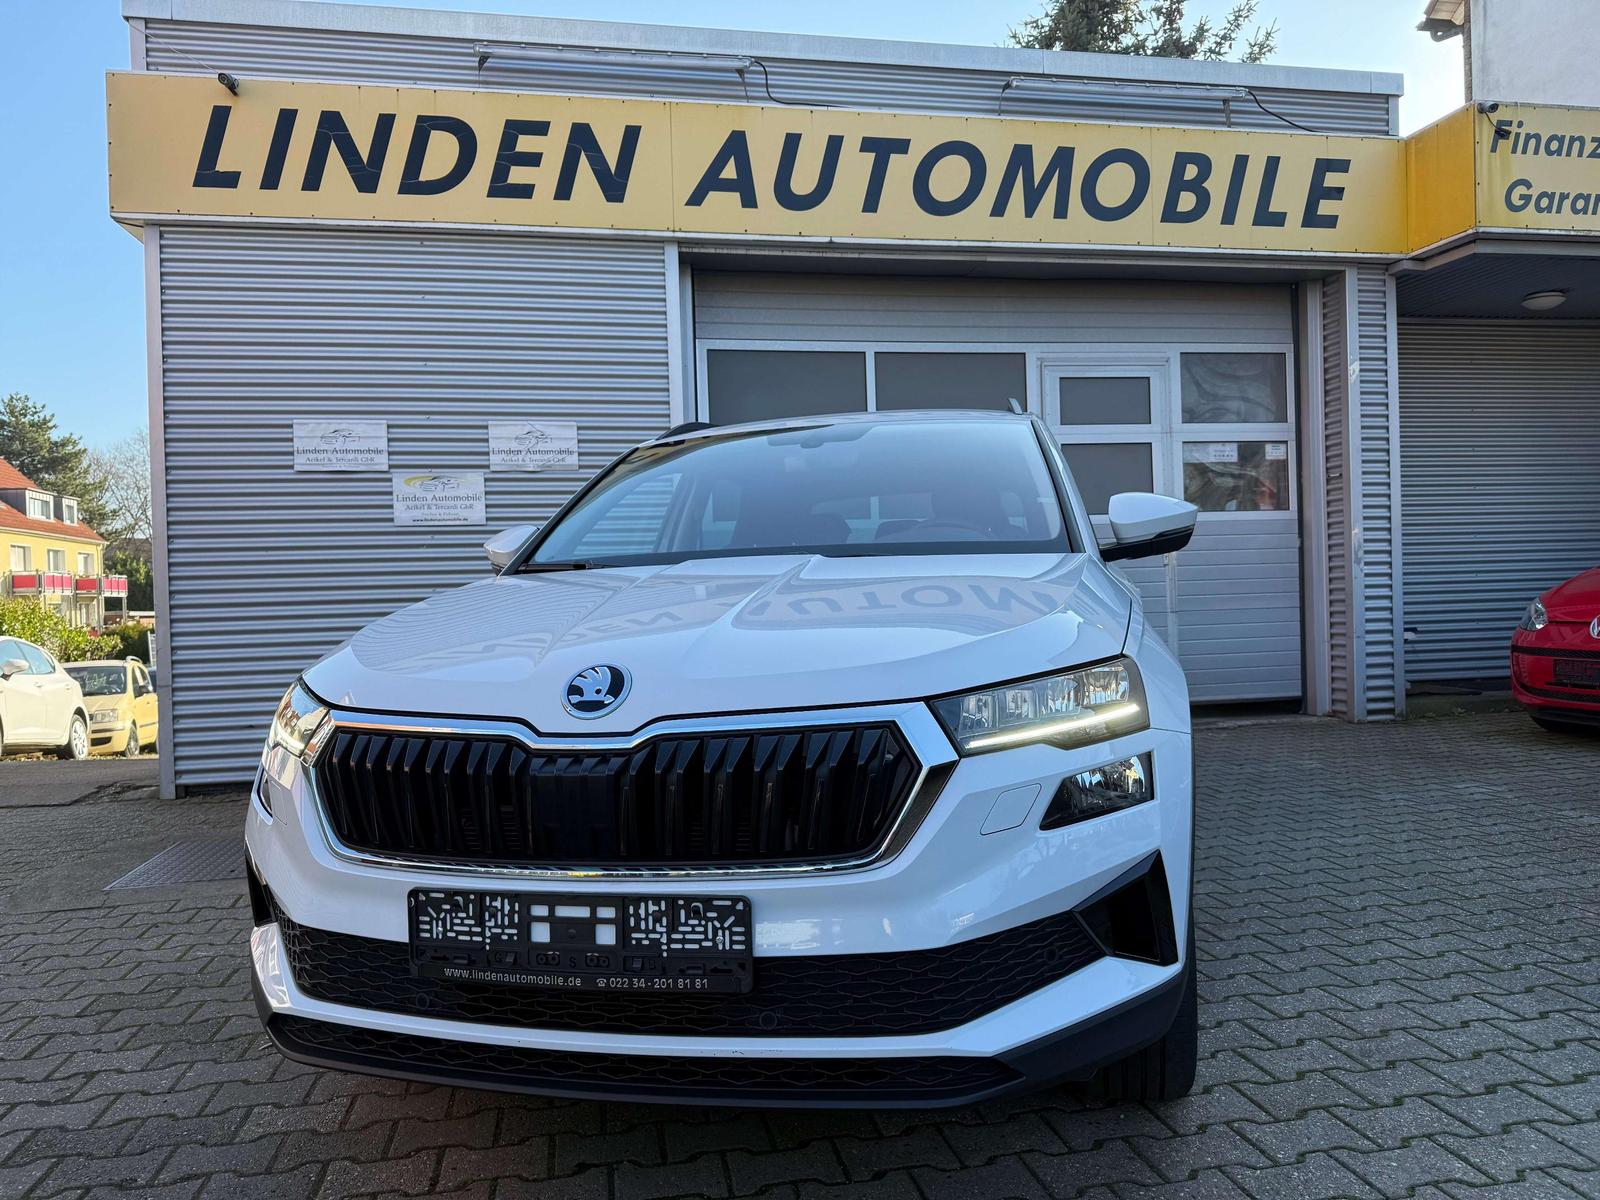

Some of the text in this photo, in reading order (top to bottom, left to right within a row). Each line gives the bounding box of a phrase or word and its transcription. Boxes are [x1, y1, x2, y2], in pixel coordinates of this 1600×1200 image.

[192, 105, 1352, 229] LINDEN AUTOMOBILE
[296, 446, 384, 456] Linden Automobile
[491, 447, 575, 456] Linden Automobile
[396, 493, 483, 502] Linden Automobile
[443, 967, 582, 986] www.lindenautomobile.de
[609, 977, 629, 988] 022
[677, 978, 691, 989] 81
[695, 978, 708, 989] 81
